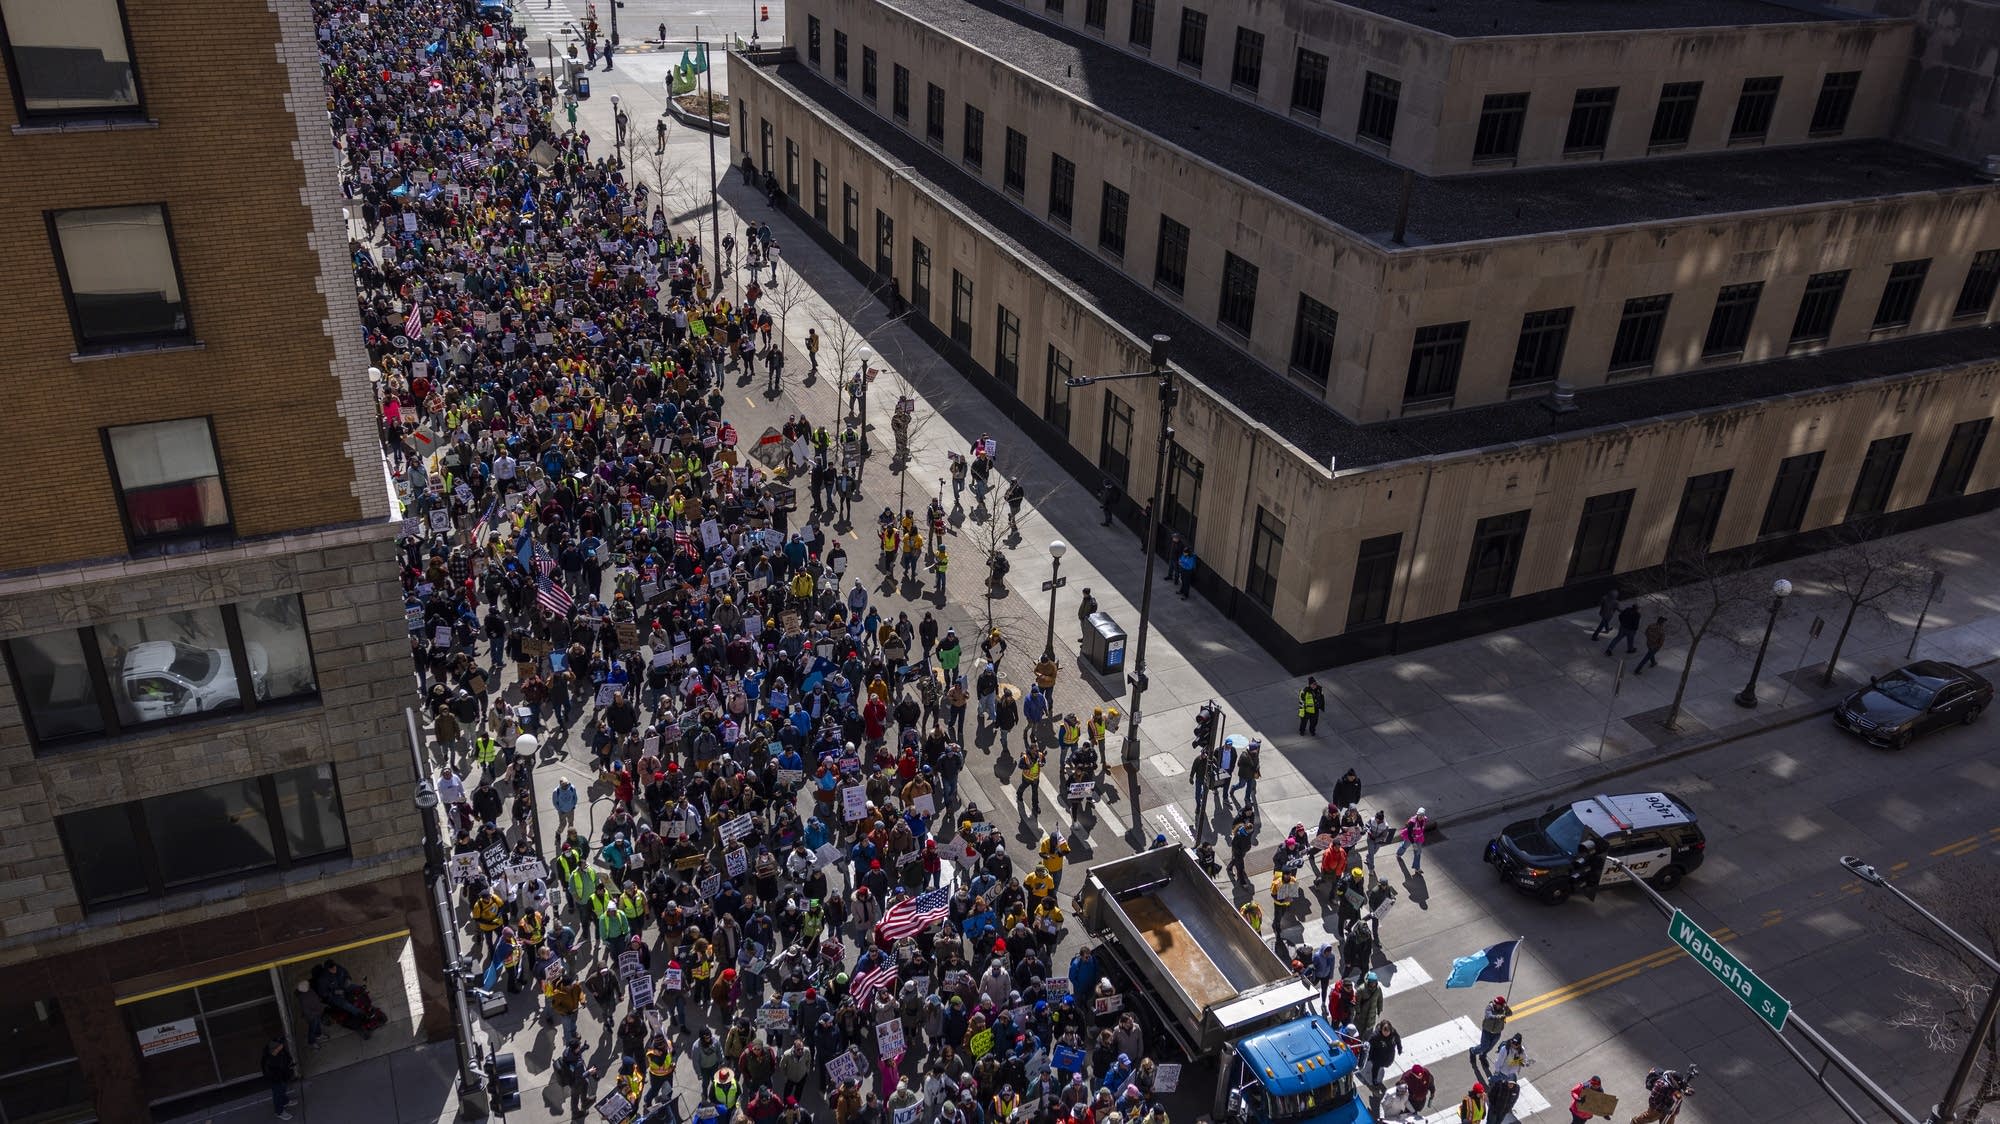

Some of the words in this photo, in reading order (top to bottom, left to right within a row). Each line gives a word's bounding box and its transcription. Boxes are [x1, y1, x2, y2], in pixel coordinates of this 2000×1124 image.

[1645, 796, 1676, 819] 1406
[483, 843, 502, 859] COME
[486, 850, 507, 867] BACK
[1604, 861, 1650, 875] POICE
[1679, 922, 1753, 998] Wabasha
[1761, 999, 1777, 1018] St
[829, 1053, 851, 1071] CLEAN
[833, 1067, 842, 1077] UP
[844, 1062, 854, 1071] ON
